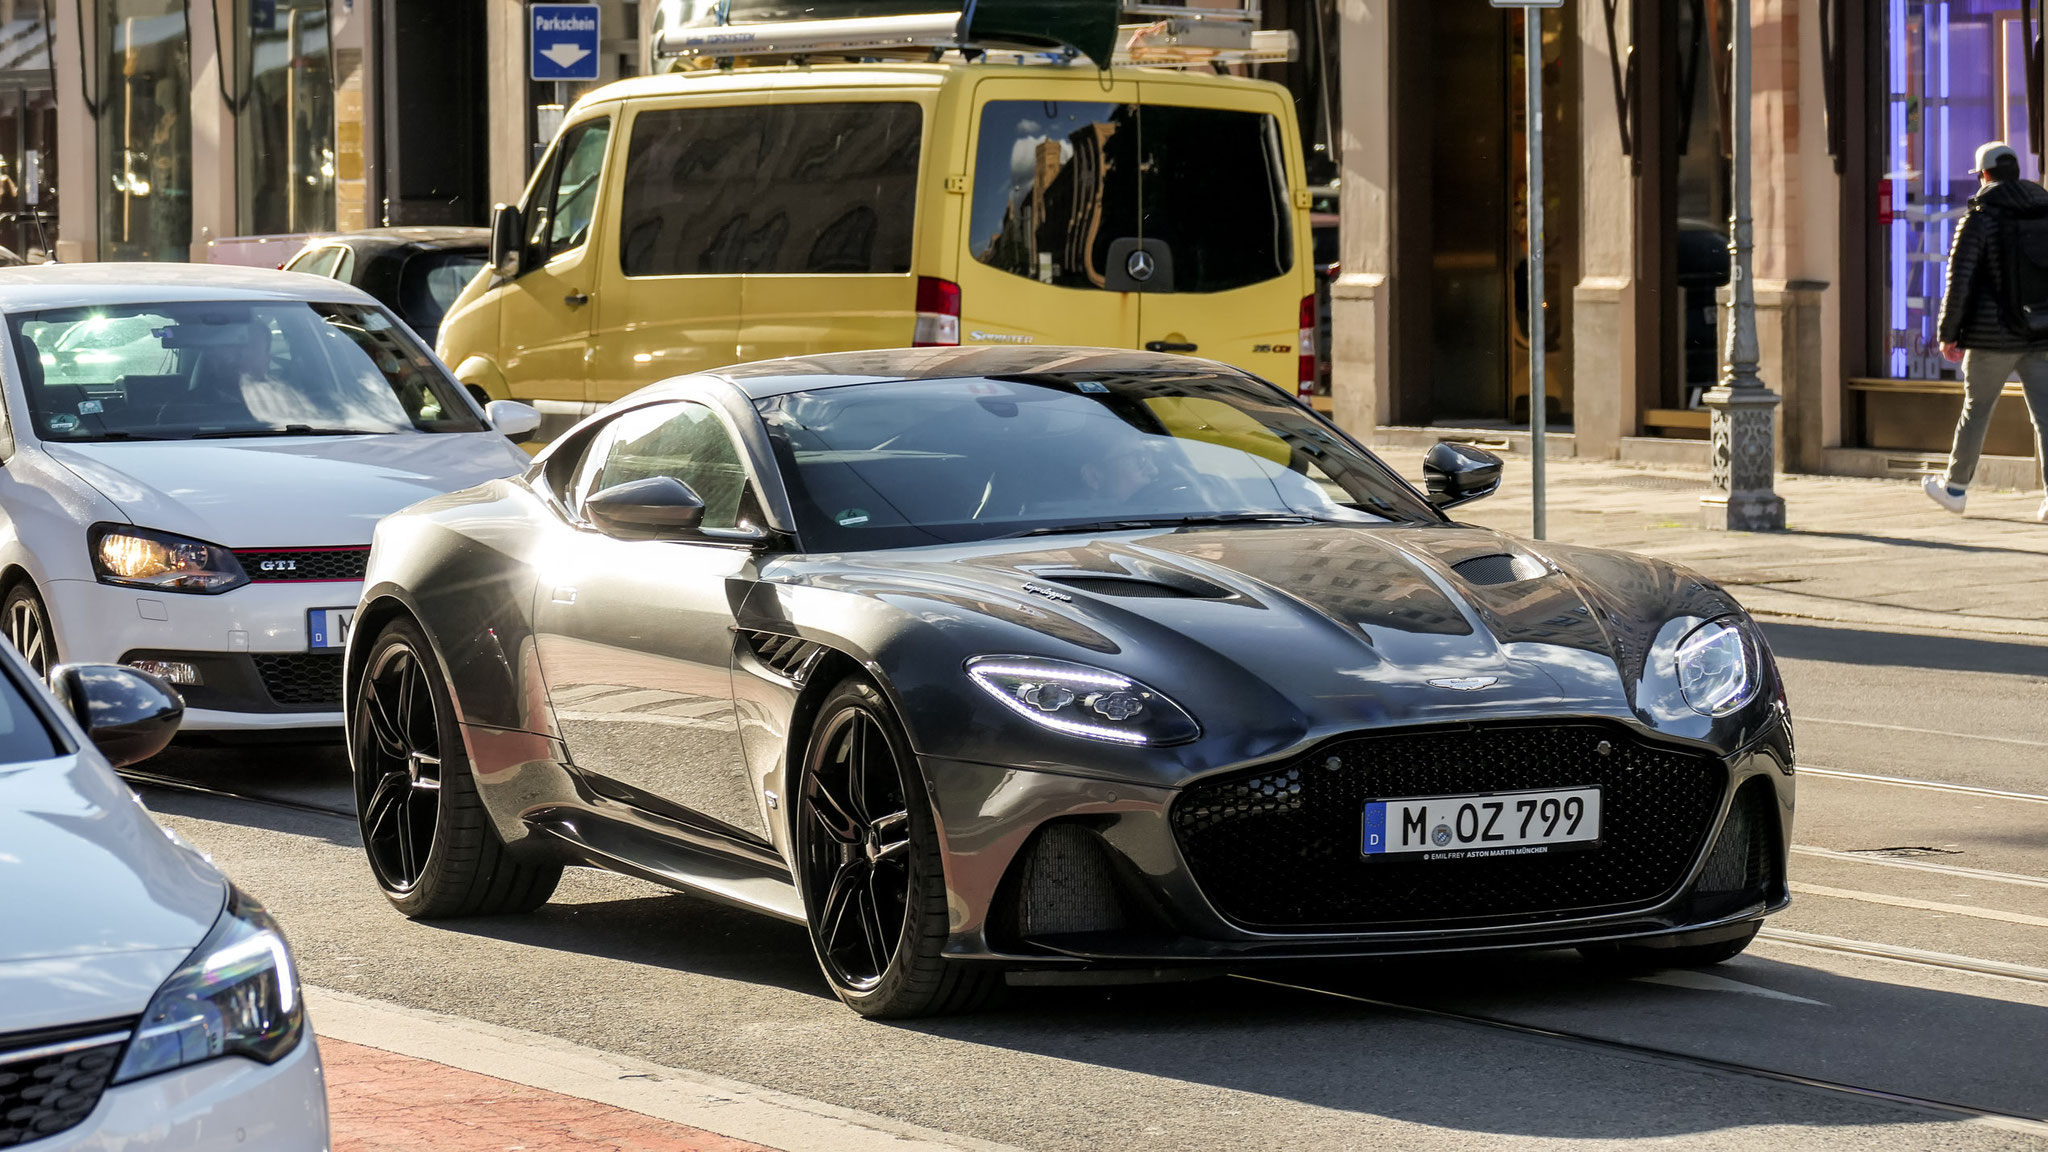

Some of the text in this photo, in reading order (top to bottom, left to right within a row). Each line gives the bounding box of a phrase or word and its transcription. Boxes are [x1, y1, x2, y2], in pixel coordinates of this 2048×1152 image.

[536, 14, 595, 31] Parkschein
[260, 560, 296, 571] GTI
[315, 633, 322, 642] D
[1403, 796, 1584, 846] M OZ 799
[1370, 834, 1379, 846] D
[1466, 850, 1489, 858] ASTON
[1490, 848, 1515, 856] MARTIN
[1515, 846, 1548, 855] MÜNCHEN
